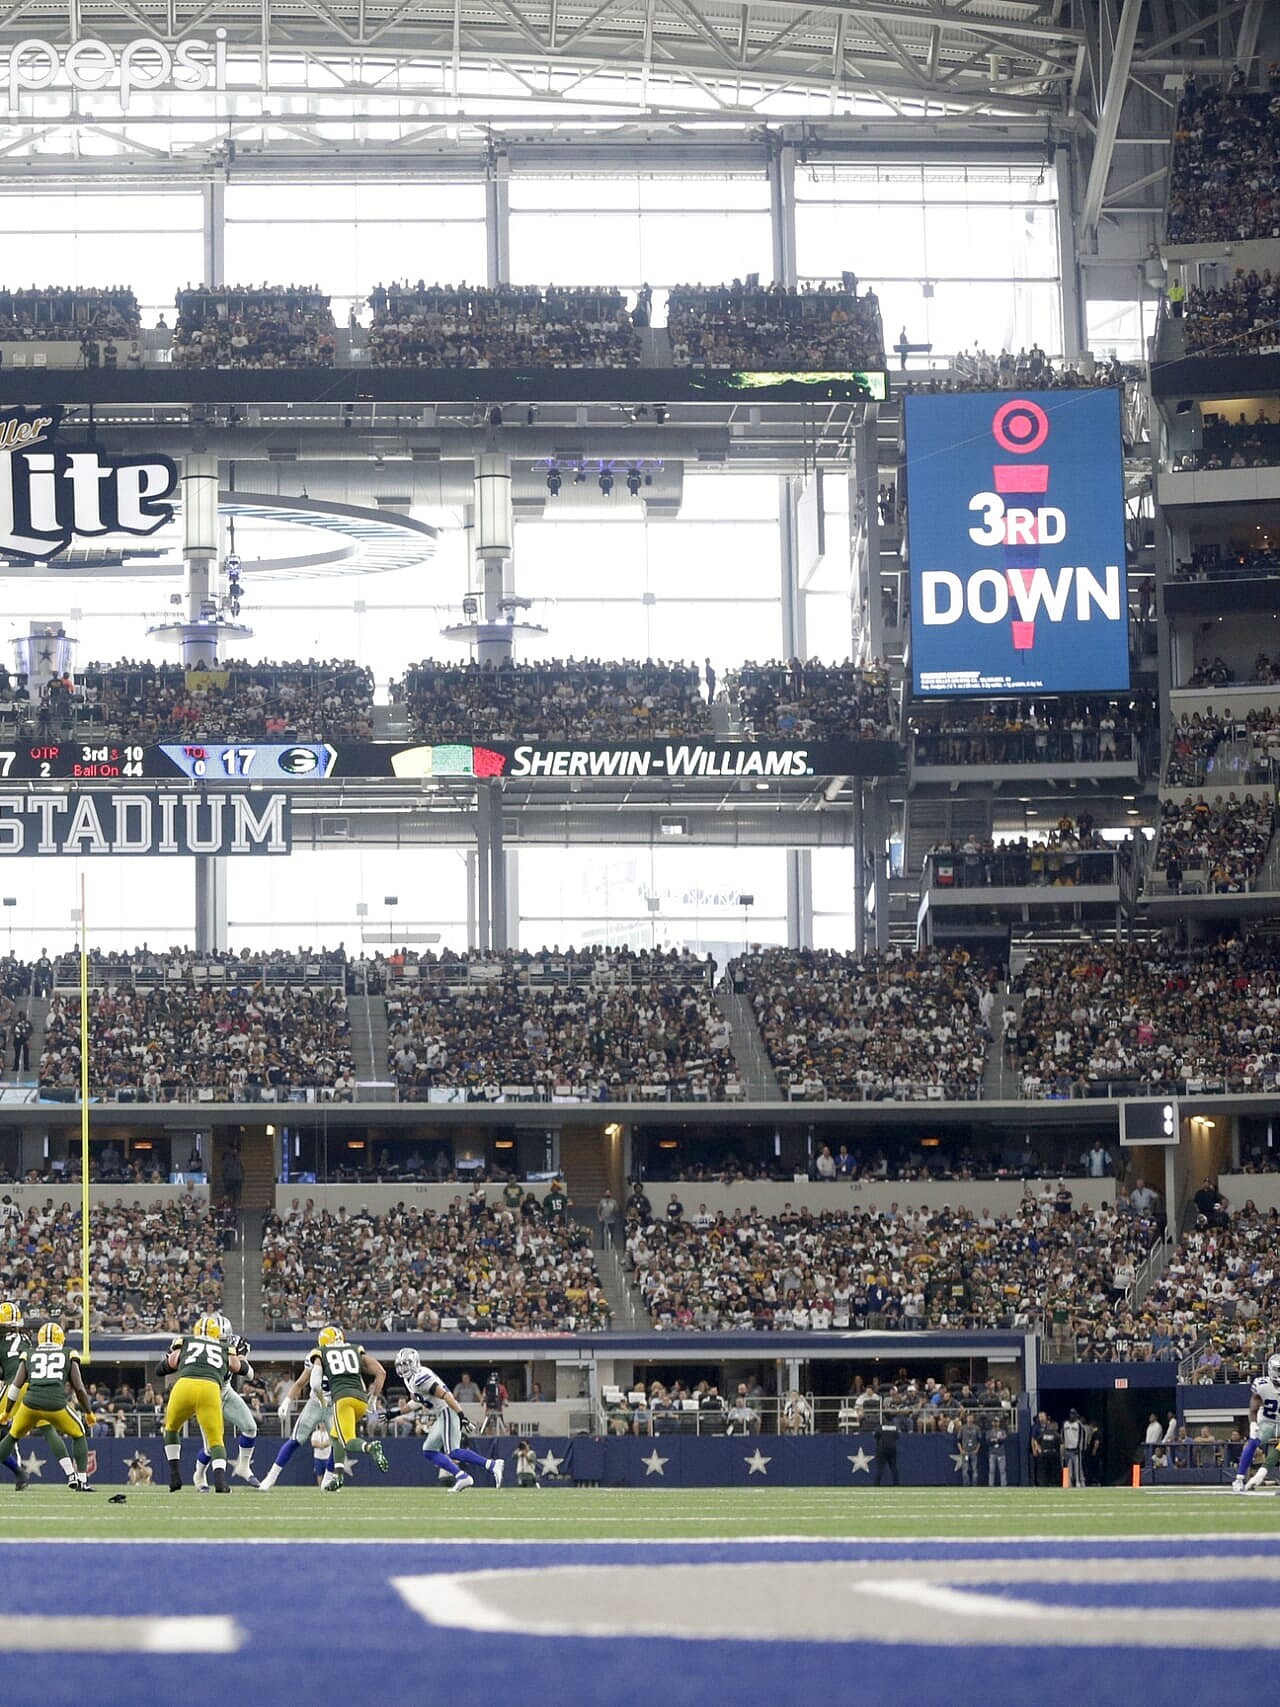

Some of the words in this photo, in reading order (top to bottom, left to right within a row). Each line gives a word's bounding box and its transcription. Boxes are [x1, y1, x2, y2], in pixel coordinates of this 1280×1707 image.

[9, 27, 228, 111] pepsi
[968, 491, 1067, 546] 3RD
[922, 566, 1120, 625] DOWN
[82, 746, 109, 762] 3rd
[123, 746, 144, 761] 10
[222, 749, 257, 775] 17
[40, 762, 51, 777] 2
[74, 764, 97, 777] Ball
[100, 764, 119, 777] On
[122, 761, 144, 777] 44
[194, 760, 206, 776] 0
[30, 1353, 66, 1380] 32
[184, 1342, 224, 1369] 75
[326, 1349, 360, 1375] 80
[1263, 1399, 1280, 1420] 2
